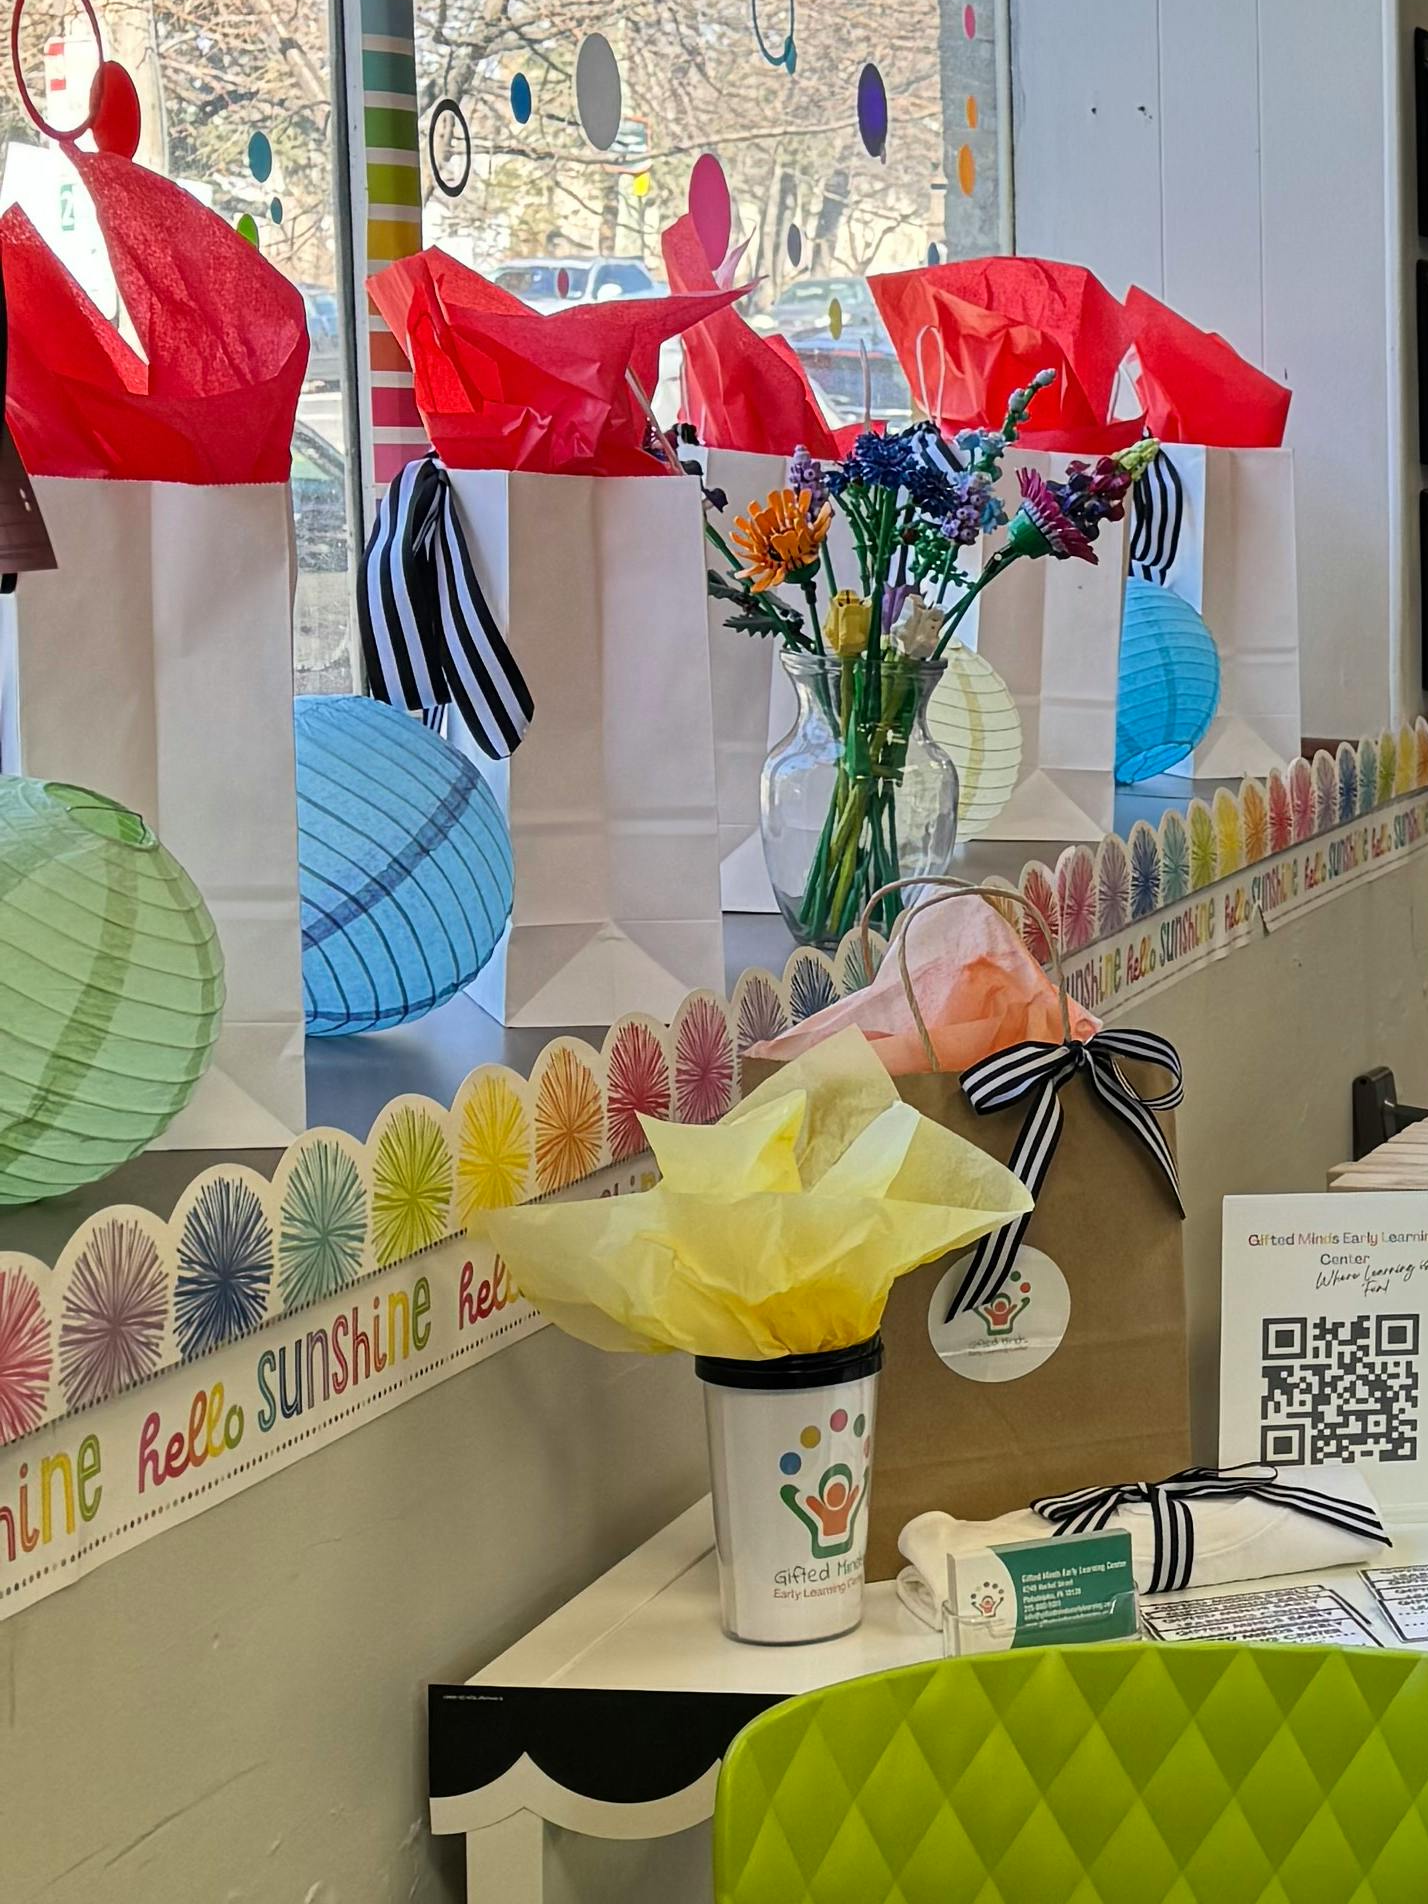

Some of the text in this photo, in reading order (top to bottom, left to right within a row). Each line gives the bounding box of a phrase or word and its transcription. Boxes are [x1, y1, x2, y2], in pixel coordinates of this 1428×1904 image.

[1126, 935, 1156, 985] hello
[1159, 897, 1215, 967] sunshine
[1224, 888, 1250, 933] hello
[1251, 858, 1298, 913] sunshine
[1304, 848, 1328, 890] hello
[1328, 828, 1368, 879] sunshine
[1248, 1232, 1295, 1246] Gifted
[1298, 1232, 1340, 1245] Minds
[1343, 1231, 1378, 1246] Early
[1320, 1253, 1370, 1266] Center
[1315, 1268, 1361, 1291] Where
[138, 1382, 245, 1494] hello
[257, 1276, 432, 1432] sunshine
[774, 1562, 830, 1585] Gifted
[774, 1588, 801, 1600] Early
